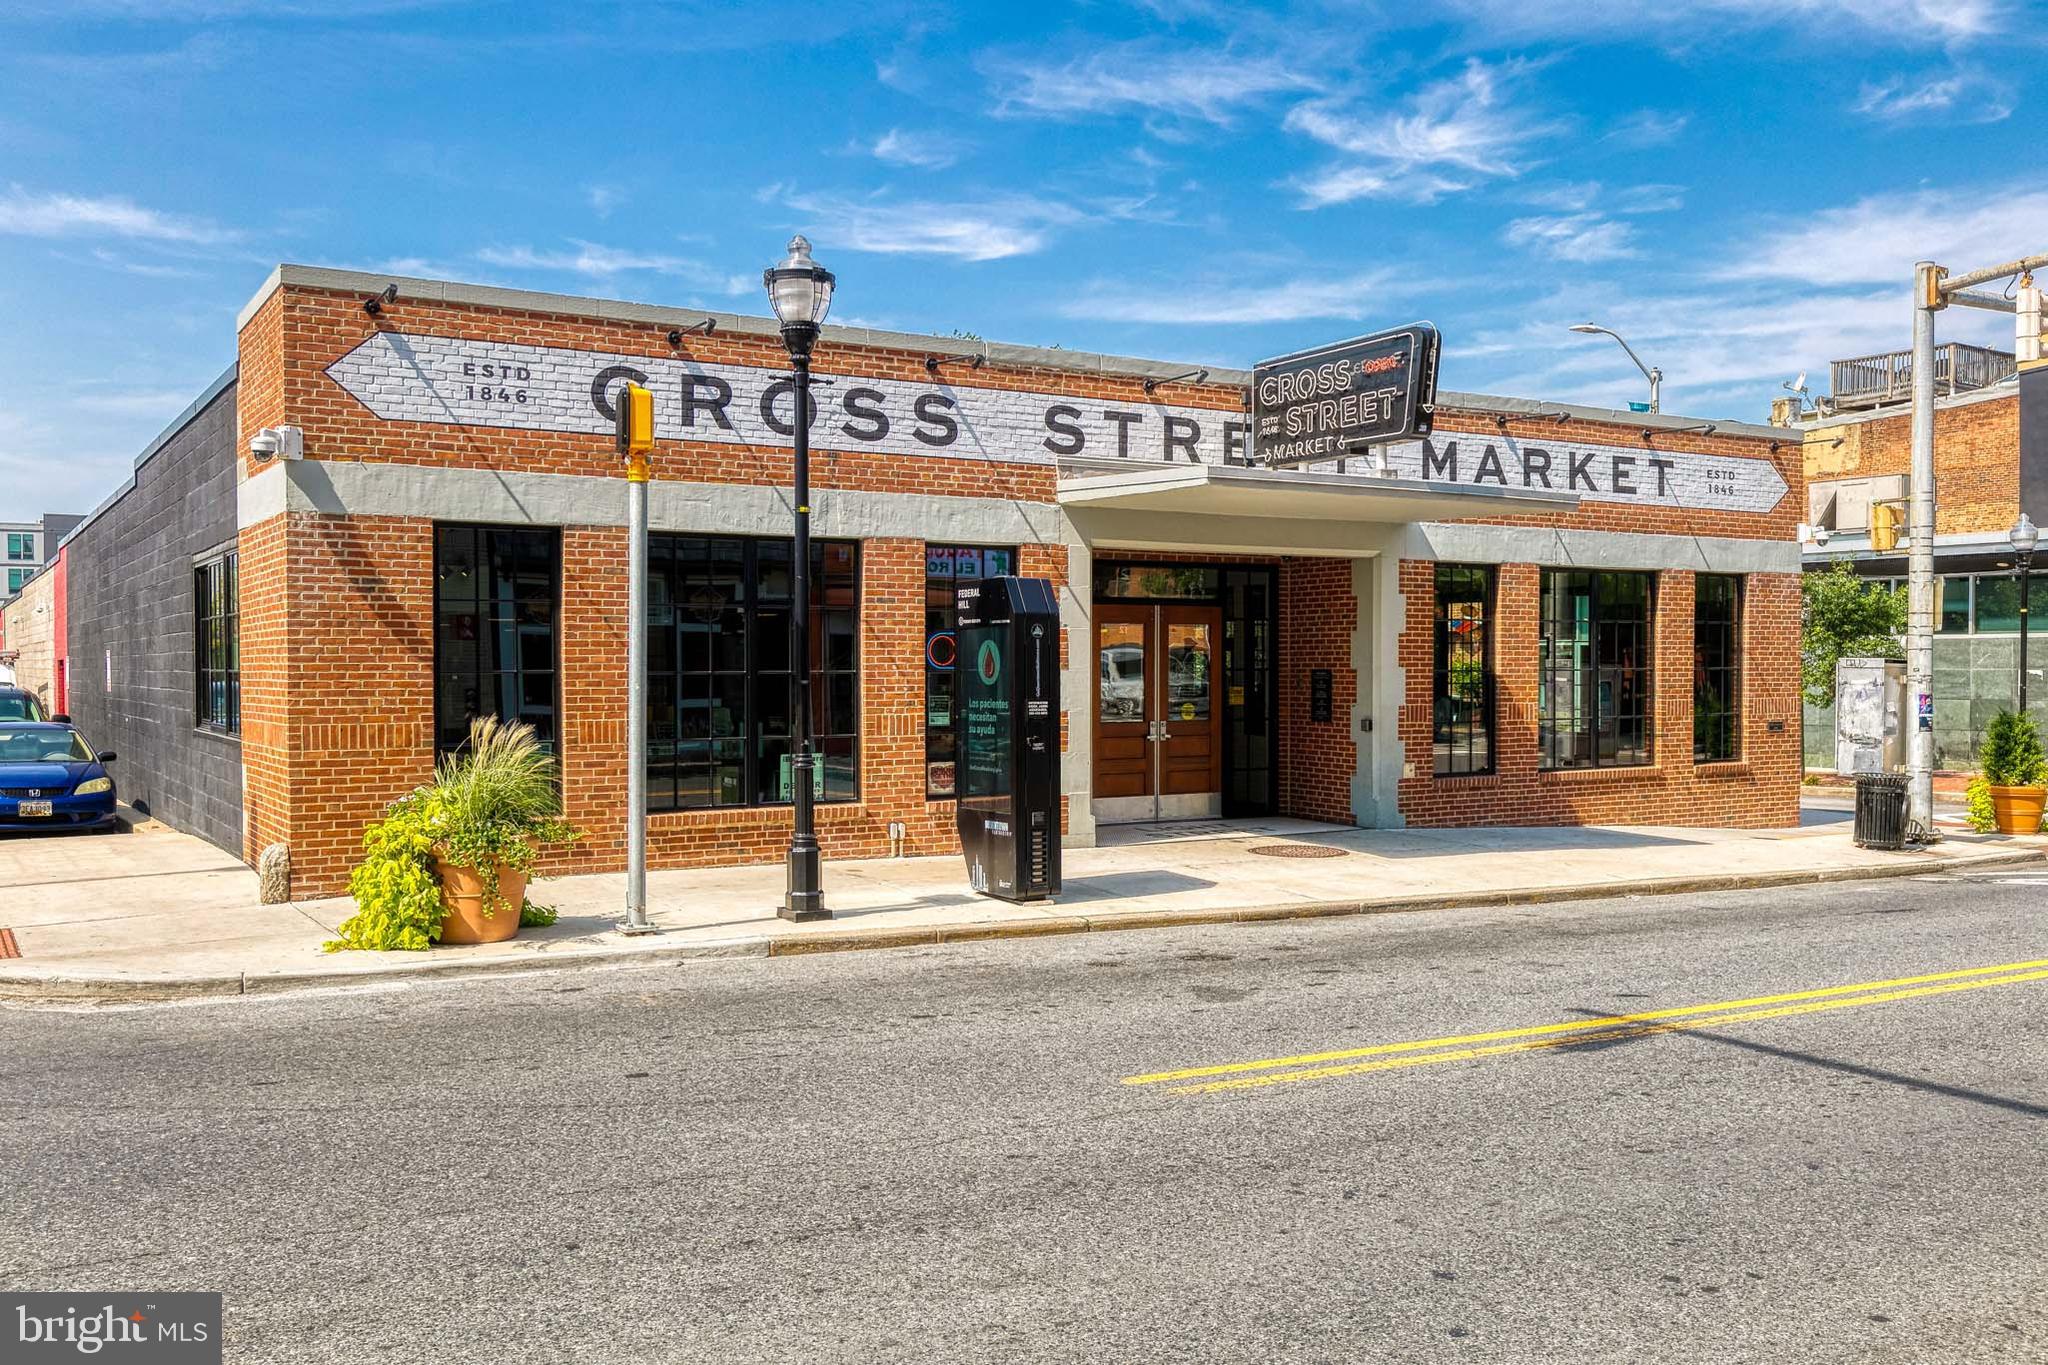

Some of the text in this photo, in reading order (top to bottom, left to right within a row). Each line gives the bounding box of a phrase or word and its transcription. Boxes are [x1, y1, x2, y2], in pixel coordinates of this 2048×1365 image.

[463, 362, 531, 382] ESTD
[1259, 360, 1351, 406] CROSS
[466, 385, 528, 403] 1846
[1286, 386, 1398, 436] STREET
[590, 365, 1674, 497] CROSS STRE MARKET
[1273, 436, 1335, 461] MARKET
[1706, 469, 1736, 481] ESTD
[1707, 483, 1735, 496] 1846
[958, 587, 981, 599] FEDERAL
[958, 600, 970, 609] HILL
[969, 697, 1009, 711] Los pacientes
[969, 711, 997, 722] necesitan
[969, 724, 996, 737] su ayuda
